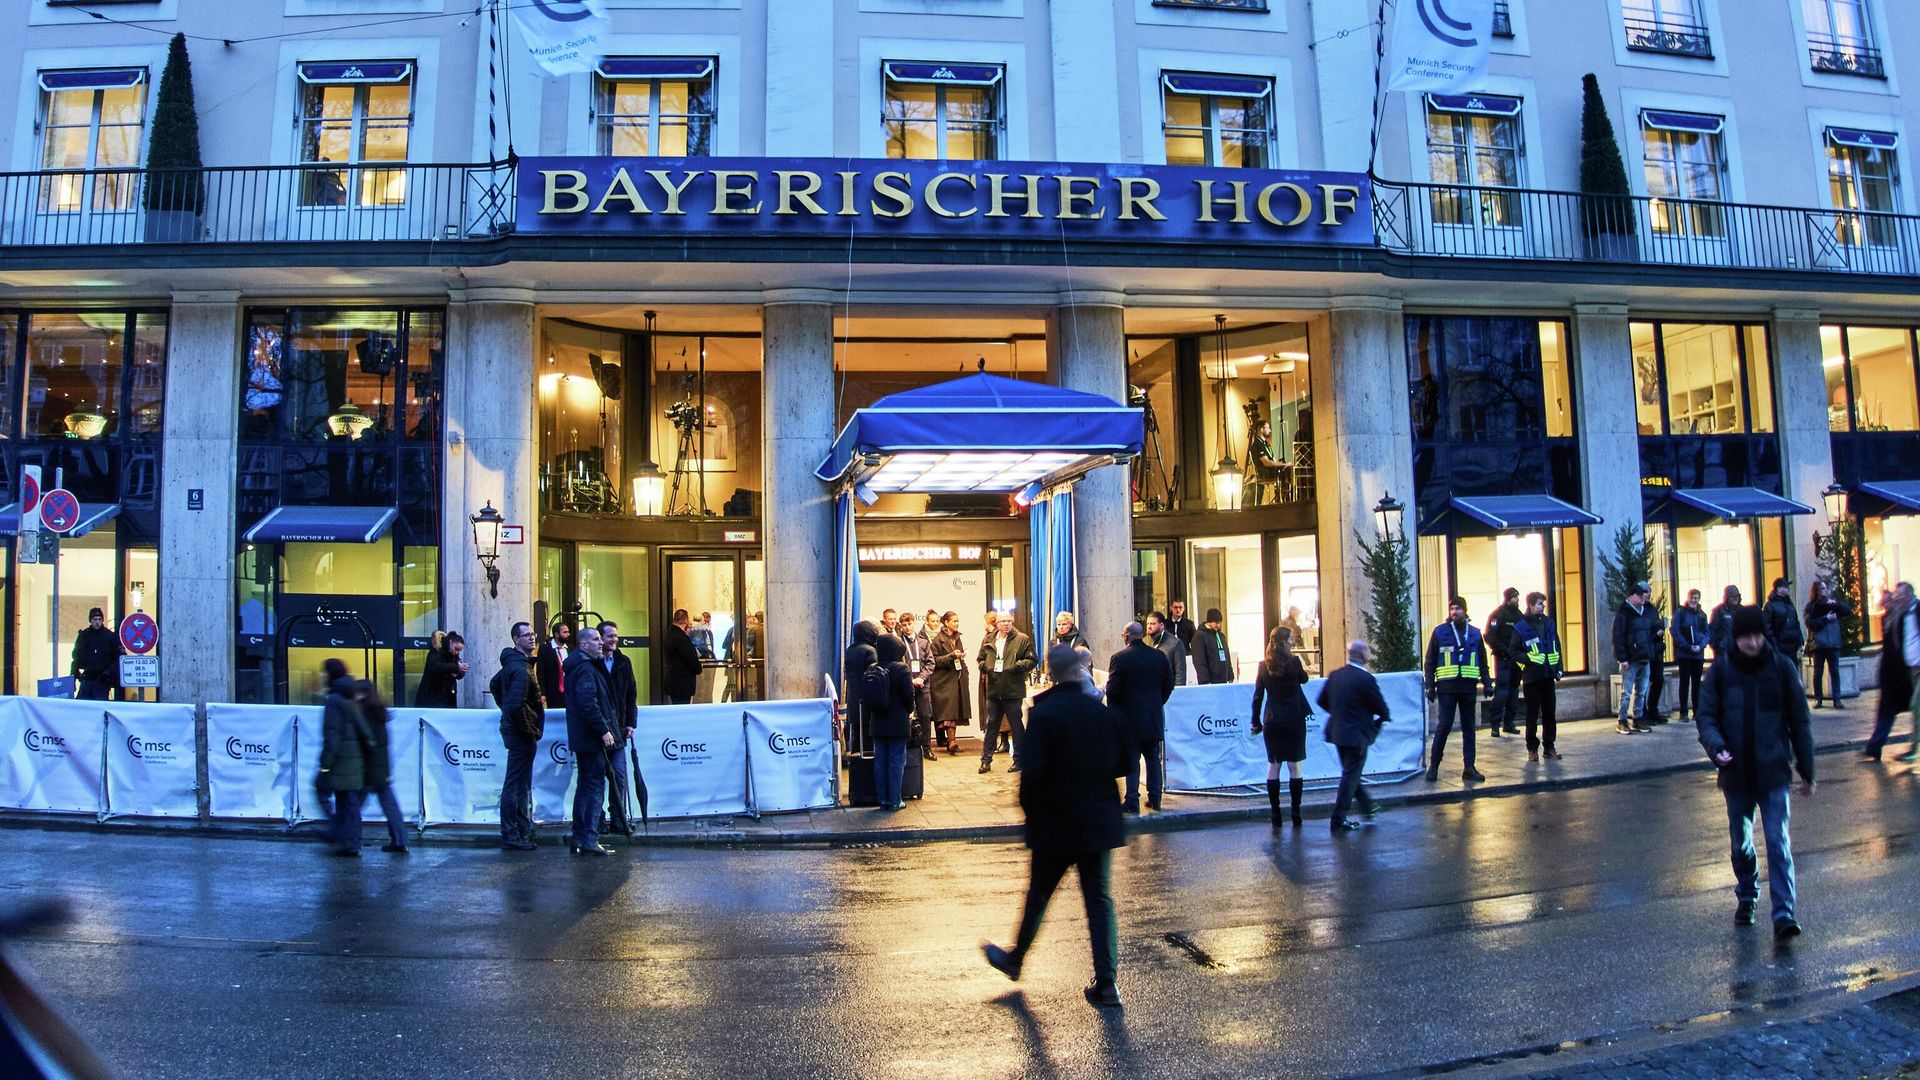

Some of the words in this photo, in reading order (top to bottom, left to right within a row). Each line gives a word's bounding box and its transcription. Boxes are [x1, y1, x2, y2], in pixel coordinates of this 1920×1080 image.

[529, 43, 562, 56] Munich
[1407, 56, 1439, 68] Munich
[1405, 67, 1454, 80] Conference
[541, 170, 1164, 220] BAYERISCHER
[1199, 180, 1356, 226] HOF
[192, 490, 199, 501] 6
[858, 547, 952, 561] BAYERISCHER
[958, 547, 982, 560] HOF
[1215, 718, 1238, 728] msc
[42, 736, 65, 746] msc
[787, 736, 810, 746] msc
[145, 742, 171, 751] msc
[244, 744, 270, 753] msc
[680, 743, 707, 753] msc
[463, 749, 490, 759] msc
